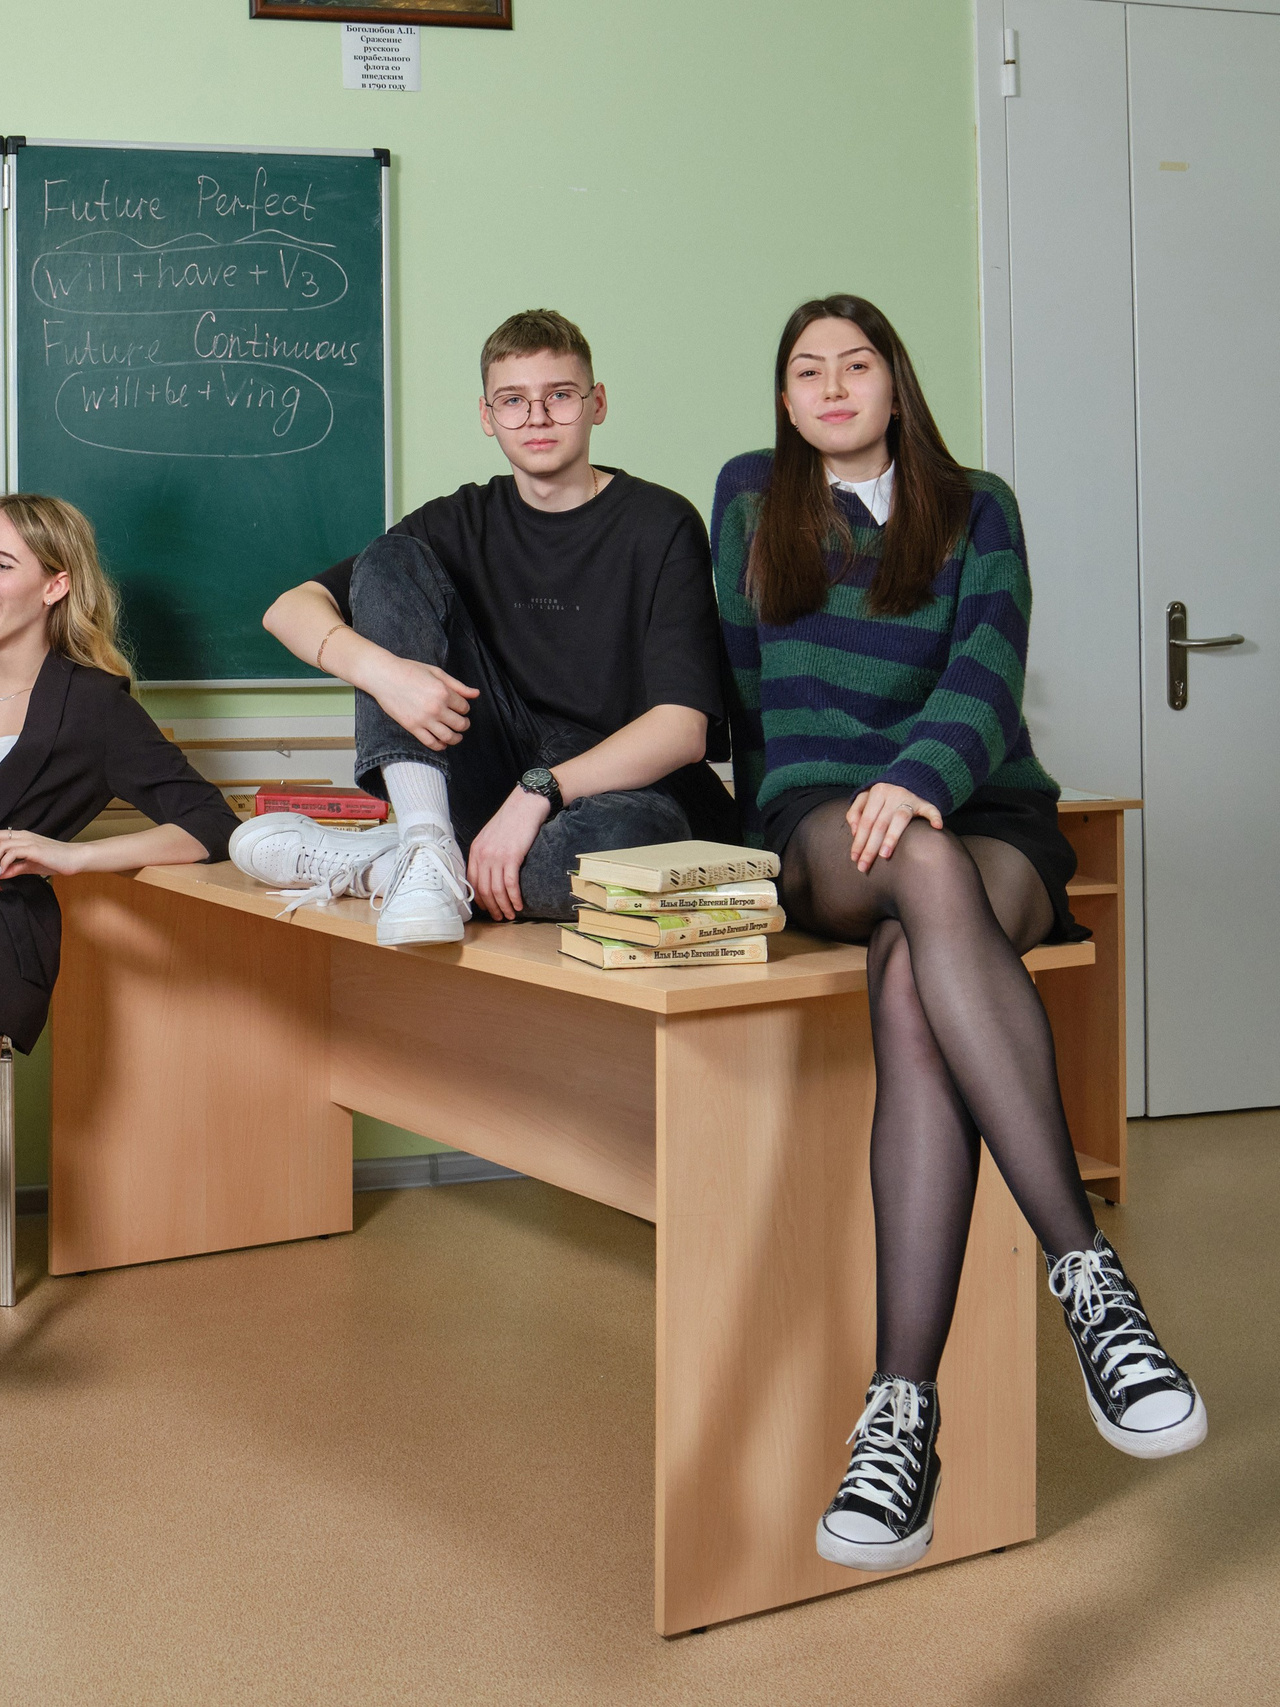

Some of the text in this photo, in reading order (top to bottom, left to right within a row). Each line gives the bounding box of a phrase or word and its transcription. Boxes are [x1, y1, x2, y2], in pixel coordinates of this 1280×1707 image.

[346, 25, 395, 34] Боголюбов
[360, 35, 402, 44] Сражение
[353, 54, 411, 62] корабельного
[364, 63, 390, 71] флота
[368, 83, 387, 91] 1790
[43, 166, 317, 231] Future Perfect
[42, 311, 360, 366] Future Continuous
[660, 897, 756, 909] Илья Ильф Евгений Петров
[698, 922, 768, 938] Илья Ильф Евгений Петров
[654, 947, 746, 960] Илья Ильф Евгений Петров
